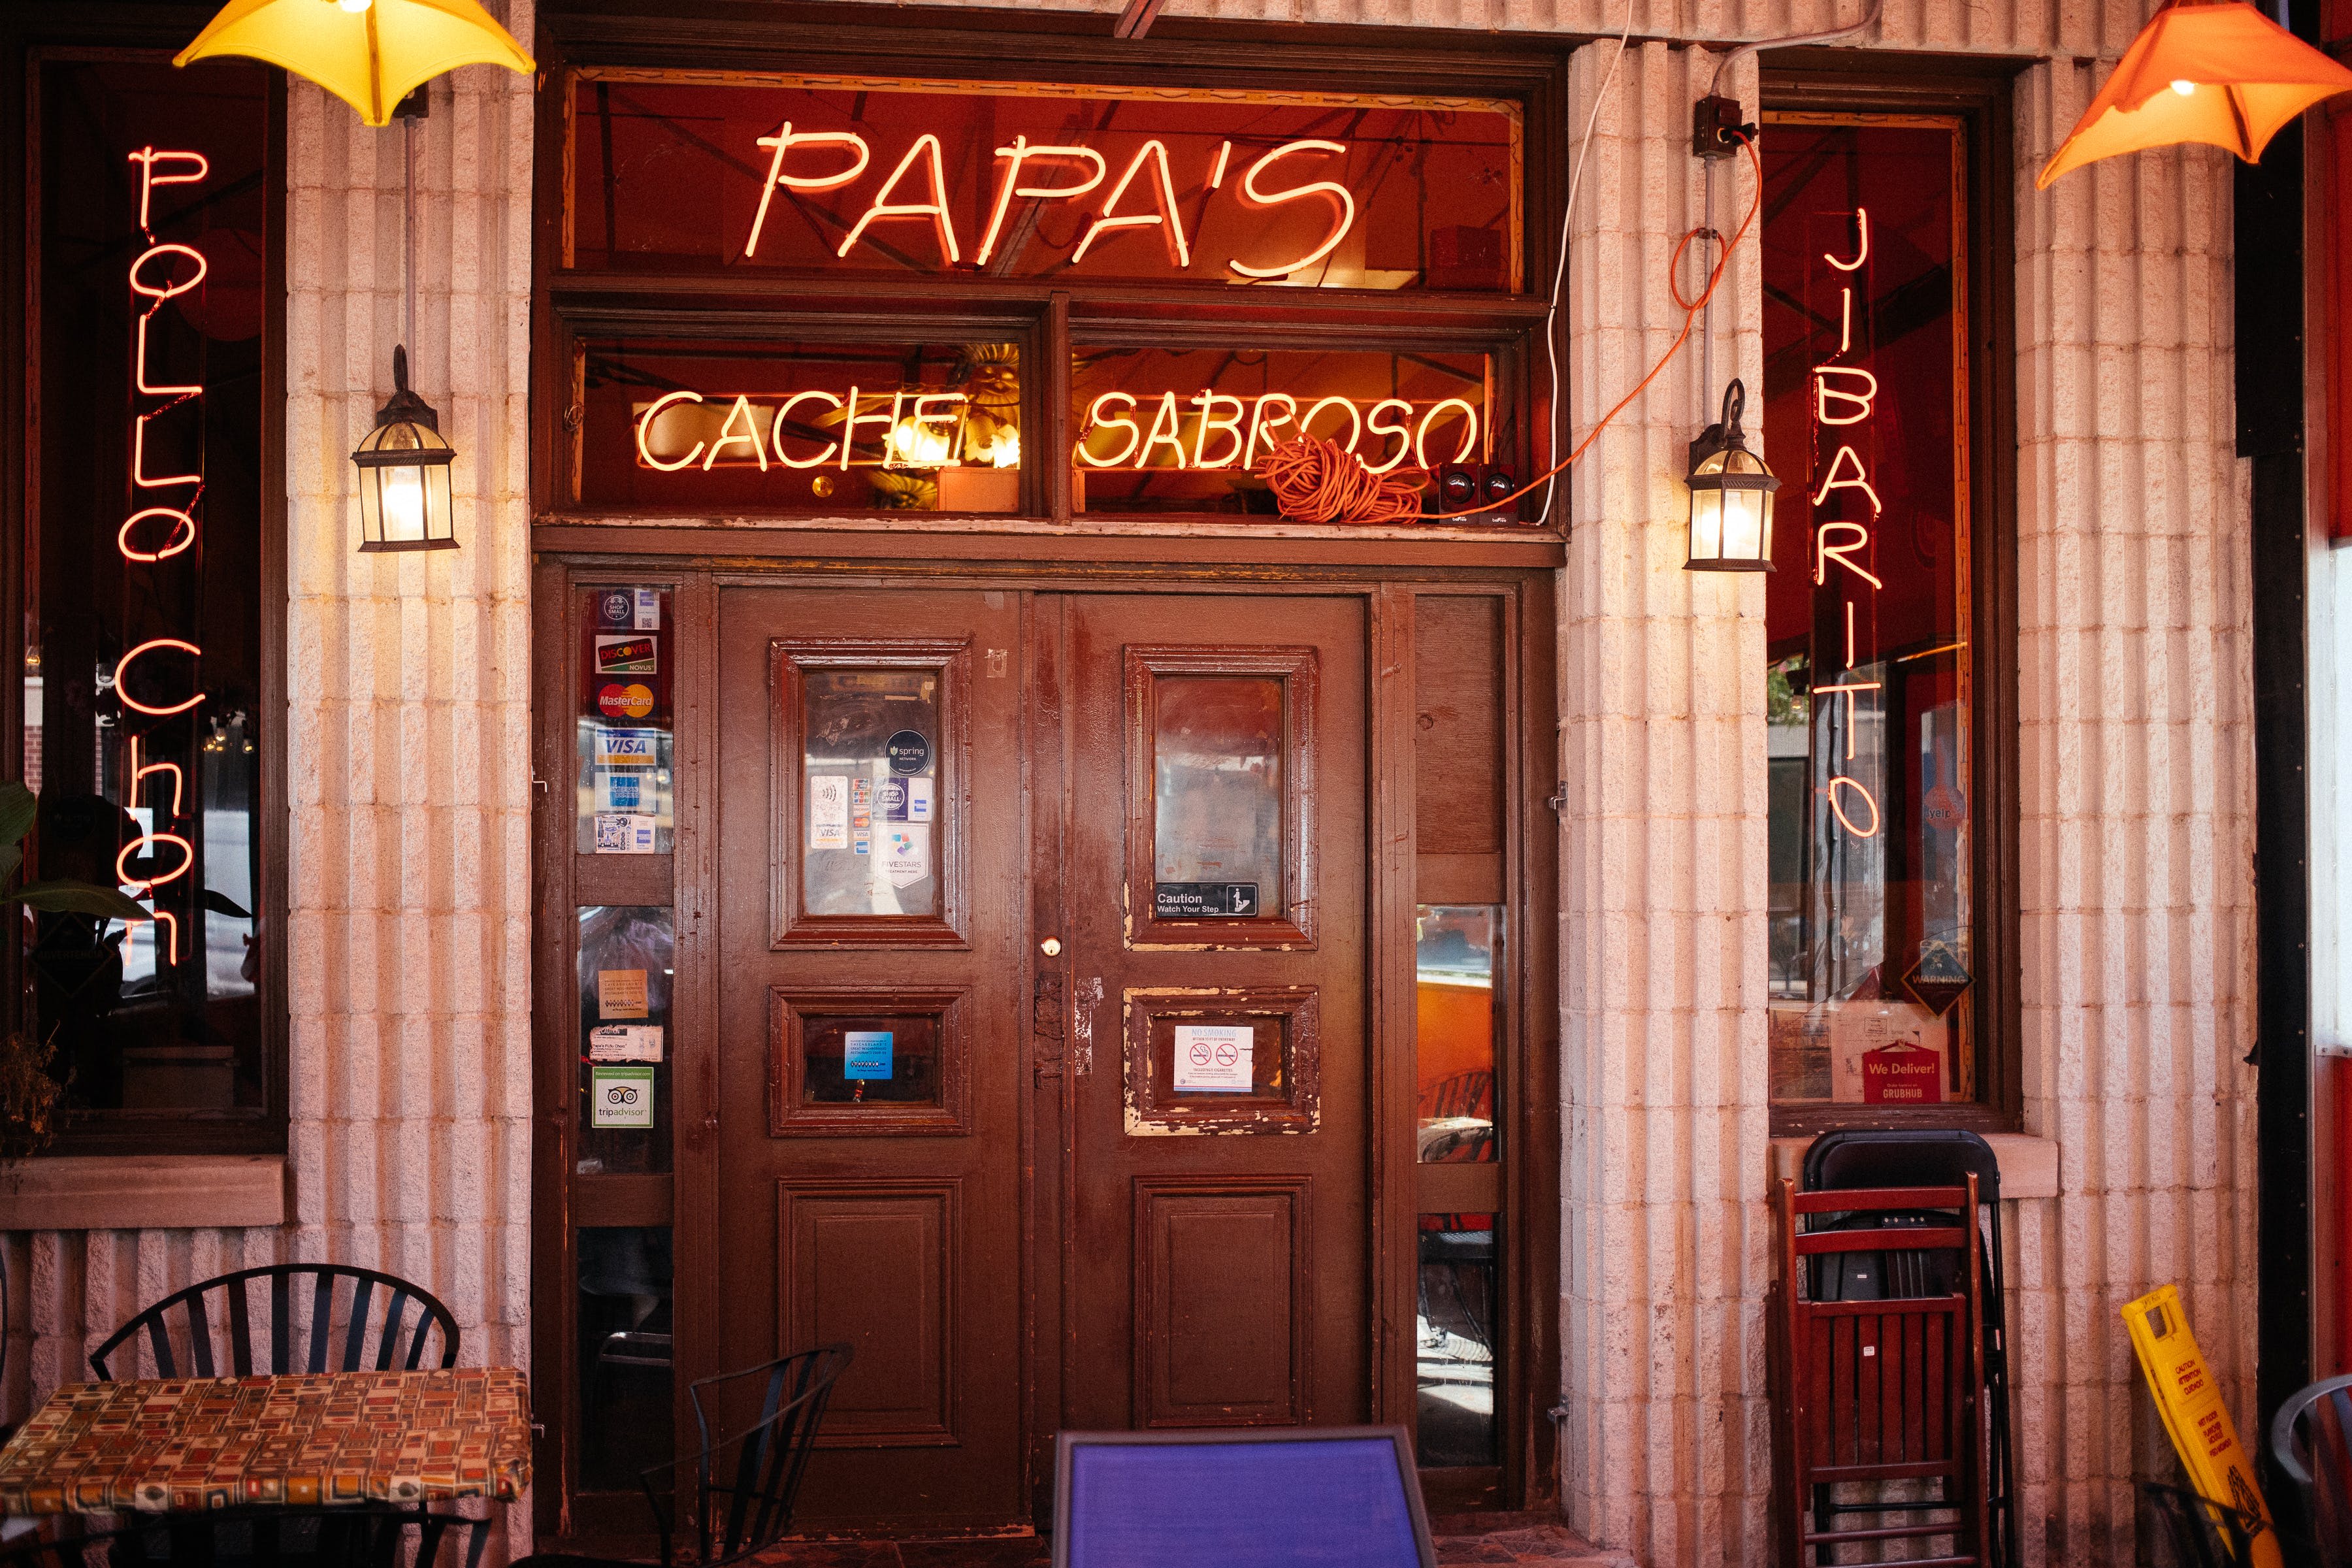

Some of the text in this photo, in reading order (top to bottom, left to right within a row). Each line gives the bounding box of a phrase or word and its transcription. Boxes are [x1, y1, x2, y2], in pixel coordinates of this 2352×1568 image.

[745, 121, 1355, 278] PAPA'S
[118, 146, 208, 561] POLLO
[638, 385, 1477, 475] CACHE SABROSO
[1812, 207, 1882, 838] JIBARITO
[600, 643, 651, 661] DISCOVER
[600, 696, 653, 706] MasterCard
[606, 739, 646, 753] VISA
[899, 747, 924, 757] spring
[1929, 808, 1951, 819] yelp
[1157, 893, 1202, 904] Caution
[1201, 906, 1219, 914] Step
[1912, 975, 1966, 984] WARNING
[1203, 1029, 1236, 1037] SMOKING
[1869, 1062, 1935, 1074] We Deliver!
[1883, 1088, 1922, 1098] GRUBHUB
[599, 1108, 644, 1117] tripadvisor
[2175, 1359, 2196, 1374] CAUTION
[2178, 1367, 2202, 1385] ATTENTION
[2184, 1379, 2204, 1395] CUIDADO
